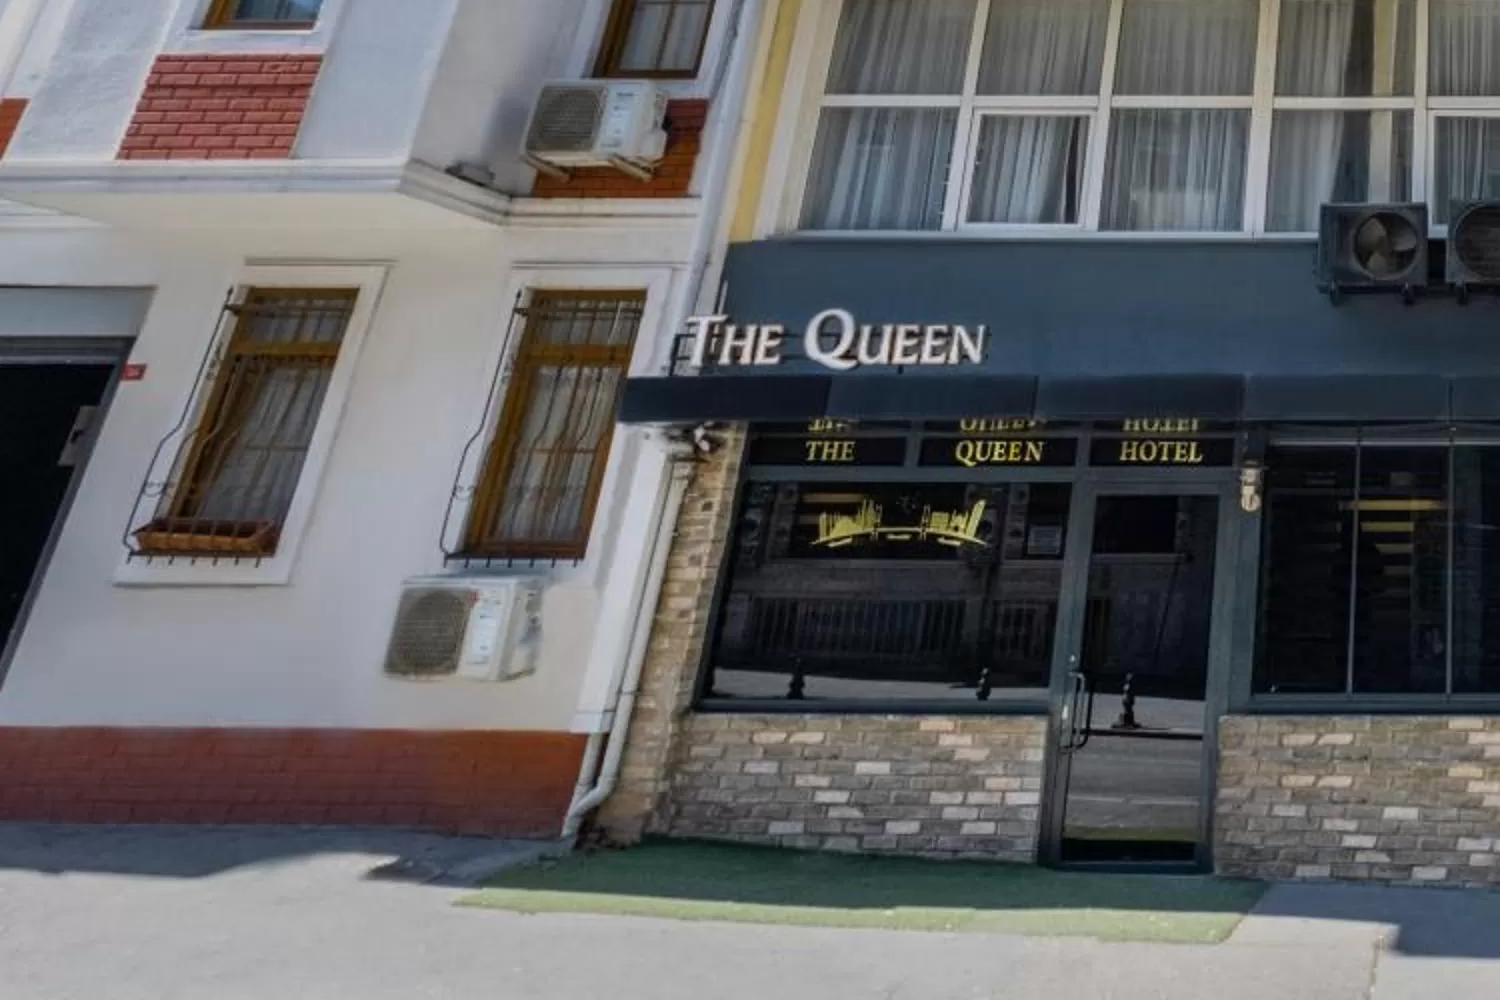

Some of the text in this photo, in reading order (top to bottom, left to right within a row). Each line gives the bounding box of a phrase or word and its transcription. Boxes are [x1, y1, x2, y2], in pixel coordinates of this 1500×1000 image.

[686, 308, 988, 370] THE QUEEN
[804, 439, 1204, 468] THE QUEEN HOTEL
